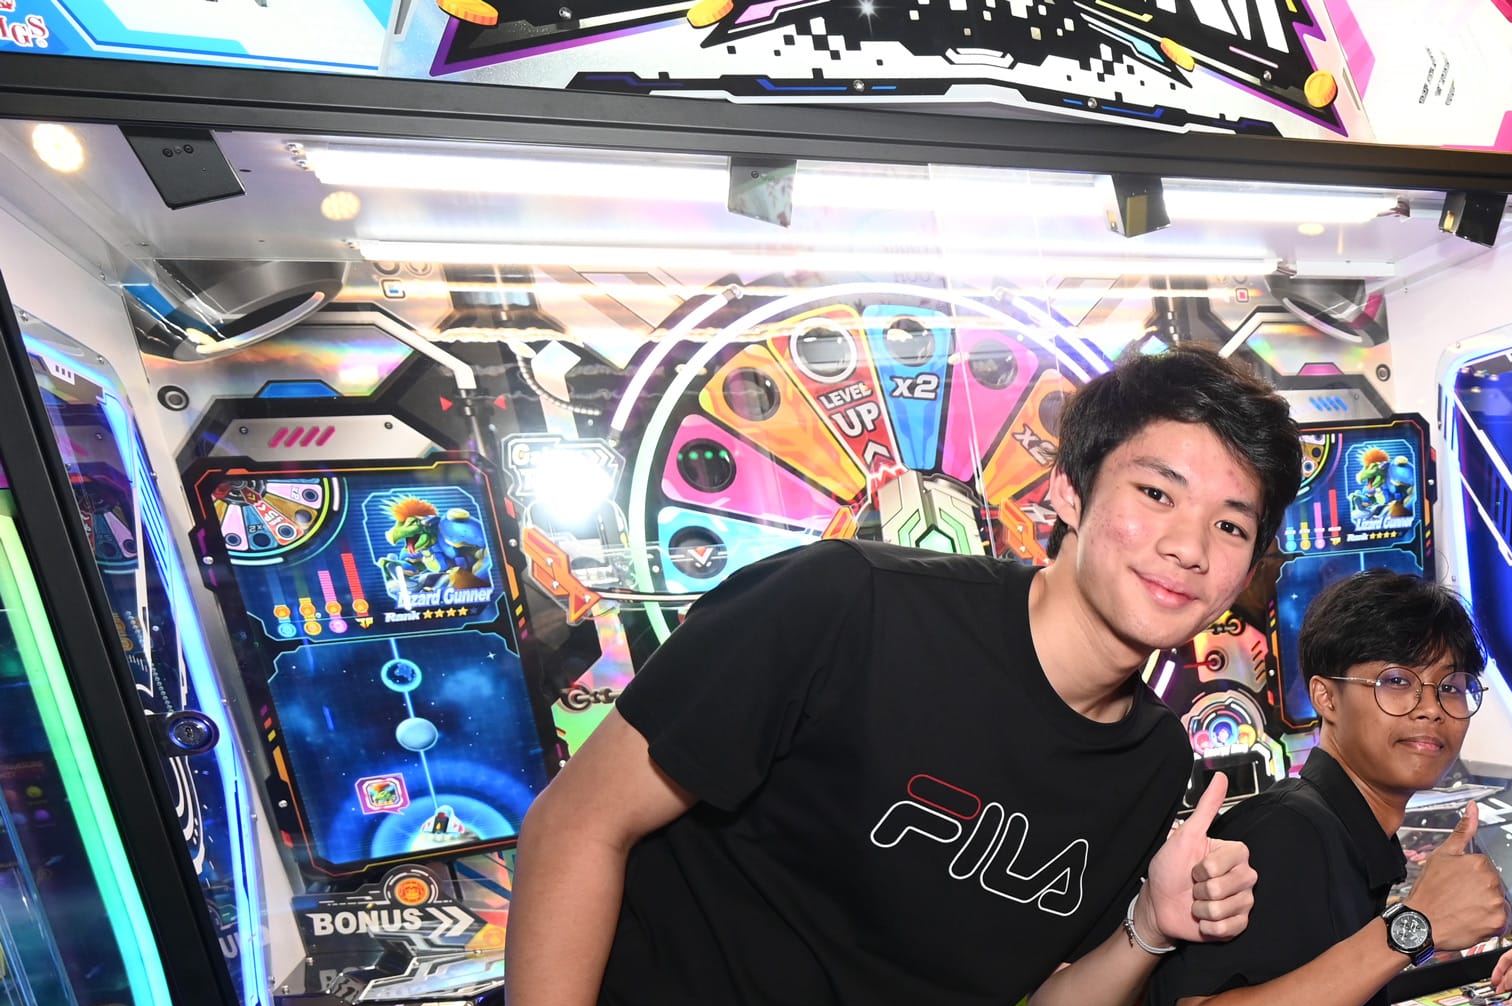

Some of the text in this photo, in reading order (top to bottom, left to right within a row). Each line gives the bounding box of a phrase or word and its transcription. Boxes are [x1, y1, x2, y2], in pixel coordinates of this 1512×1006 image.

[819, 381, 873, 410] LEVEL
[891, 374, 940, 400] x2
[830, 401, 880, 437] UP
[443, 587, 494, 605] Gunner
[383, 610, 421, 623] Rank
[870, 773, 1089, 917] FILA
[305, 908, 424, 936] BONUS
